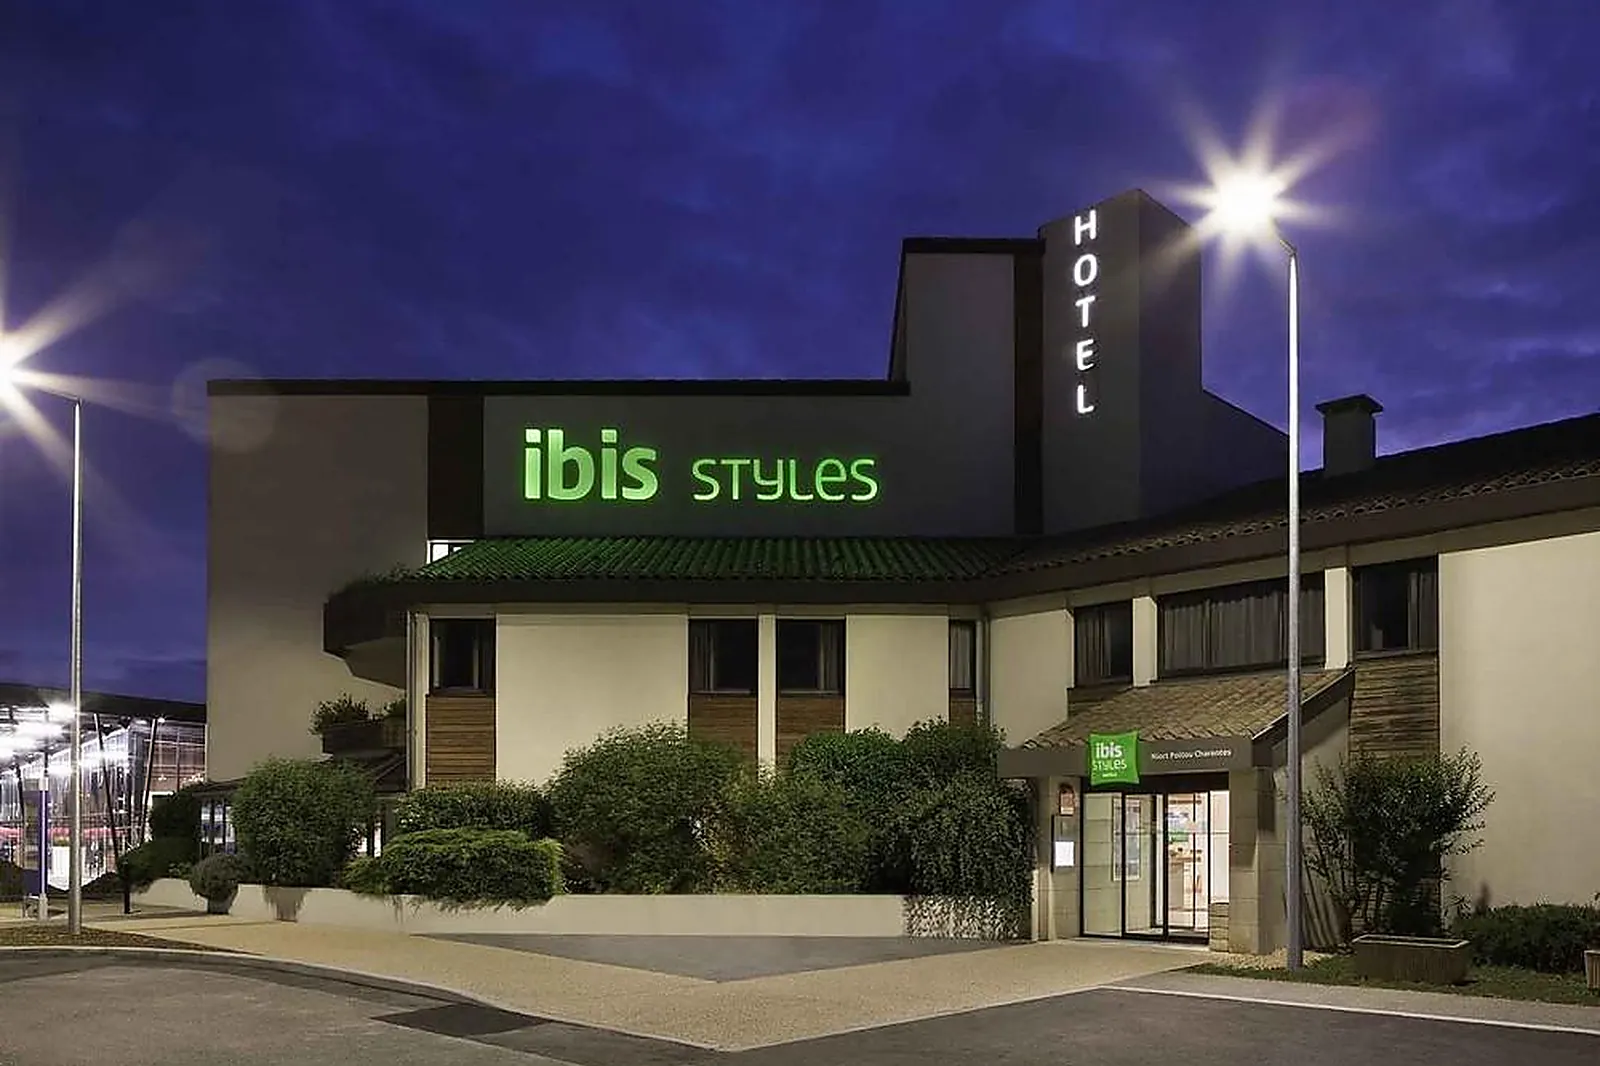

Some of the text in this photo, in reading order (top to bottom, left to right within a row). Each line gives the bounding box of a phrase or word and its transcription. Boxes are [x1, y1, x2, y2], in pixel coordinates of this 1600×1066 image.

[1074, 209, 1097, 414] HOTEL
[525, 428, 658, 500] ibis
[1096, 742, 1122, 758] ibis
